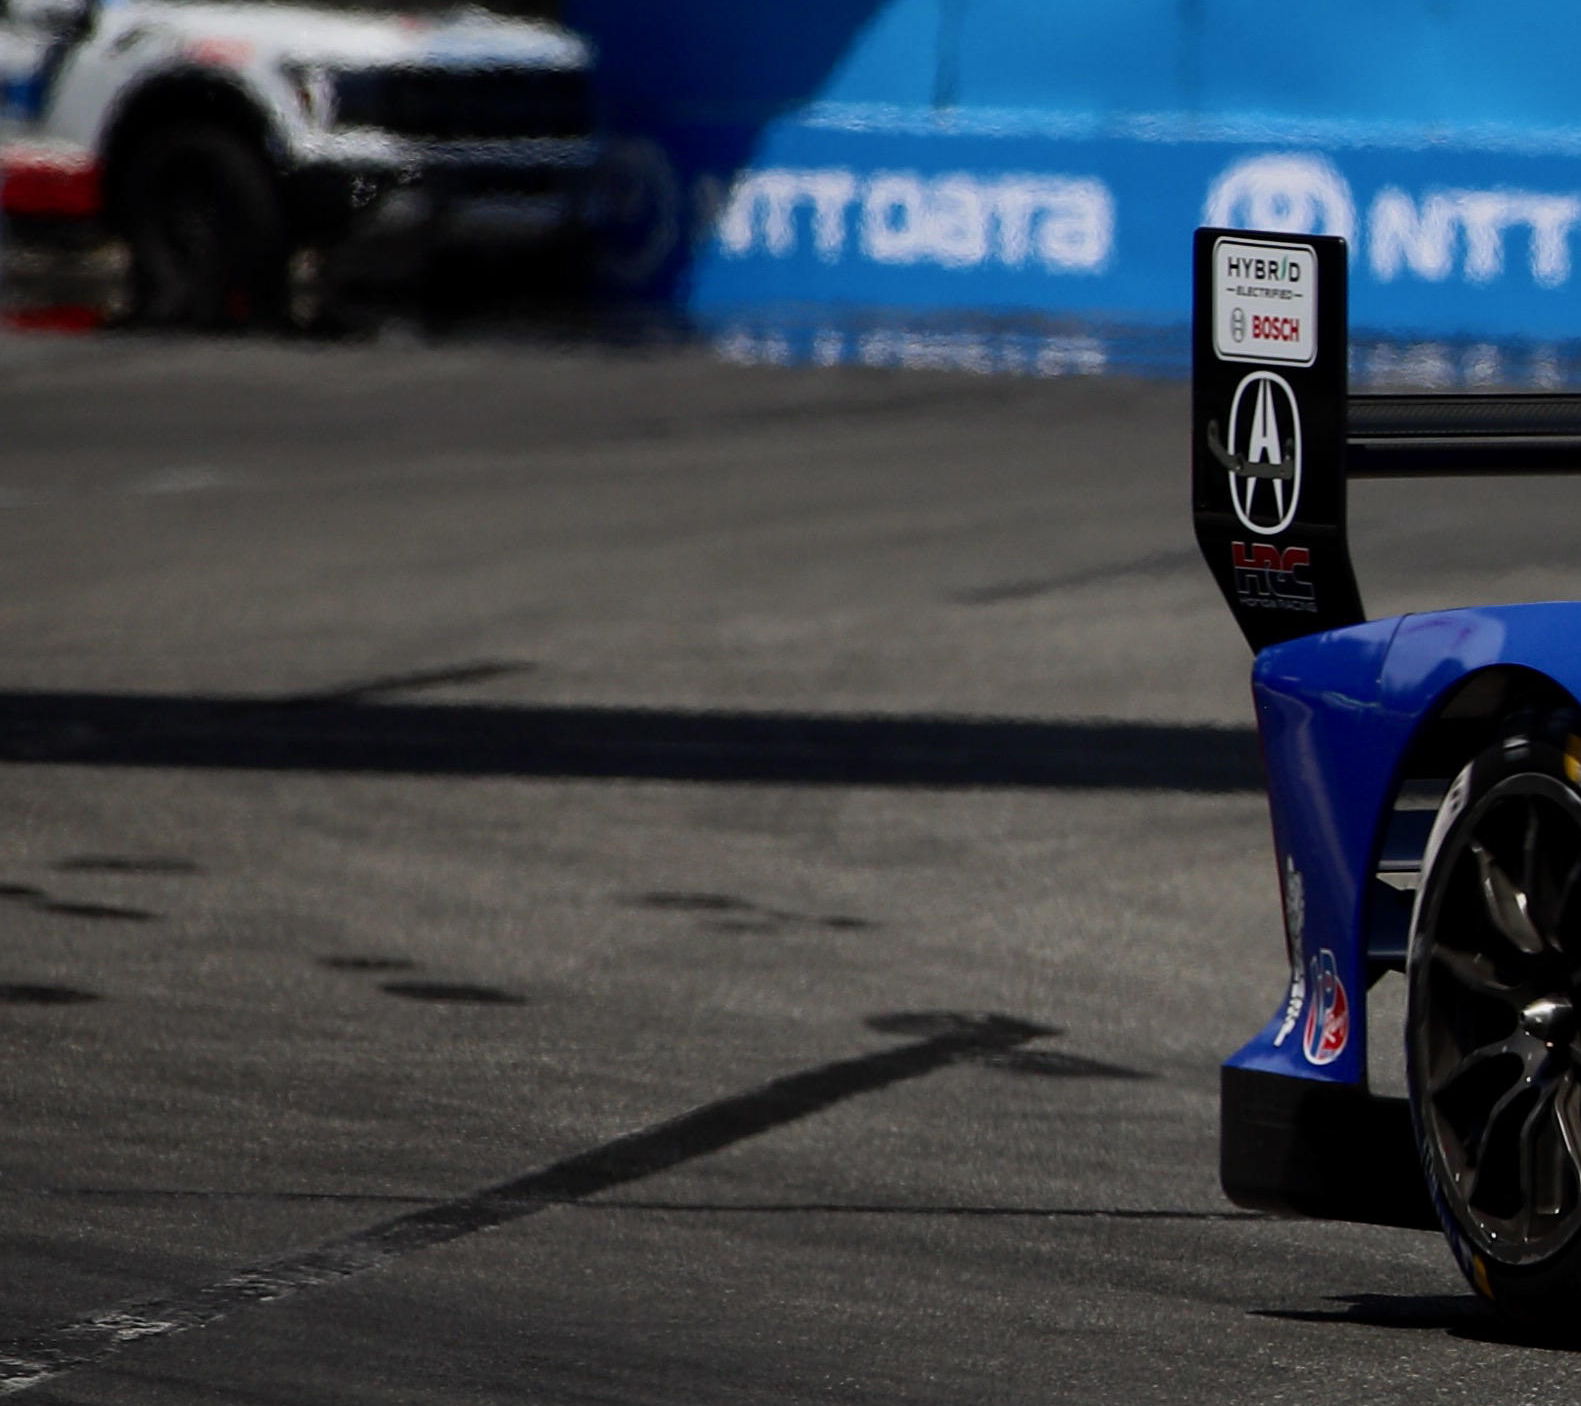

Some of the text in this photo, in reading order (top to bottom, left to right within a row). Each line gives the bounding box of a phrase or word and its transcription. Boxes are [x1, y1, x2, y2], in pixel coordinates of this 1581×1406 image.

[1366, 188, 1580, 287] NTT
[1227, 256, 1301, 283] HYBRID
[1252, 315, 1300, 342] BOSCH
